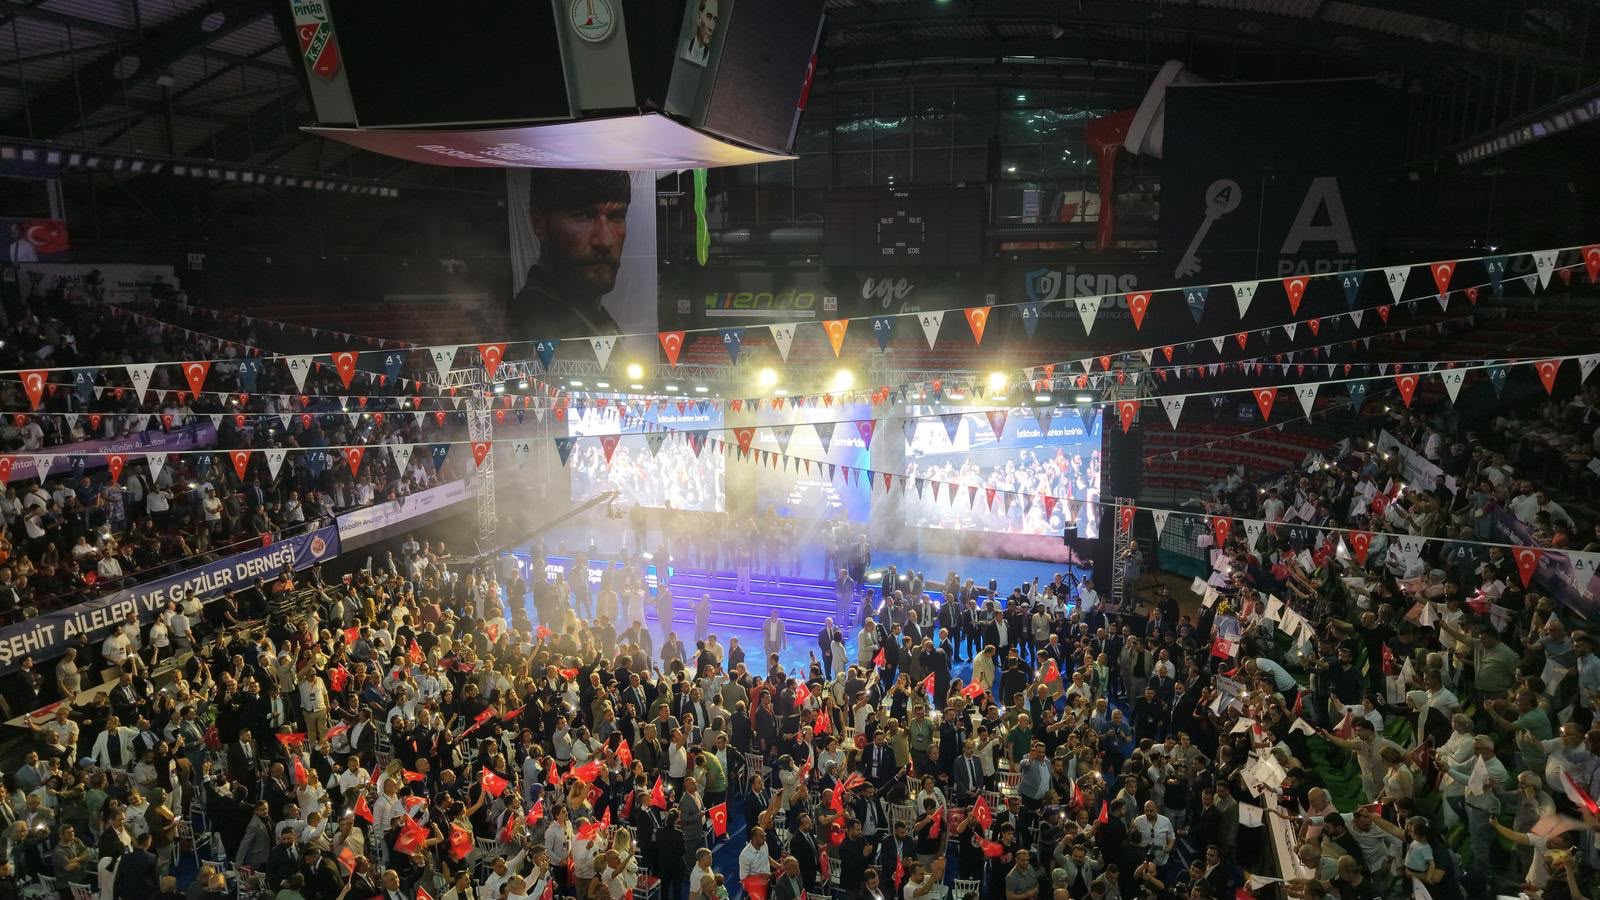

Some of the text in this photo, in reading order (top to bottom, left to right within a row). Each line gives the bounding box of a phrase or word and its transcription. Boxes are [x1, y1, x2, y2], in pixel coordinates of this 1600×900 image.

[1280, 176, 1358, 254] A
[0, 623, 55, 667] ŞEHİT
[141, 589, 165, 611] VE
[169, 568, 234, 602] GAZİLER
[235, 543, 295, 581] DERNEĞİ
